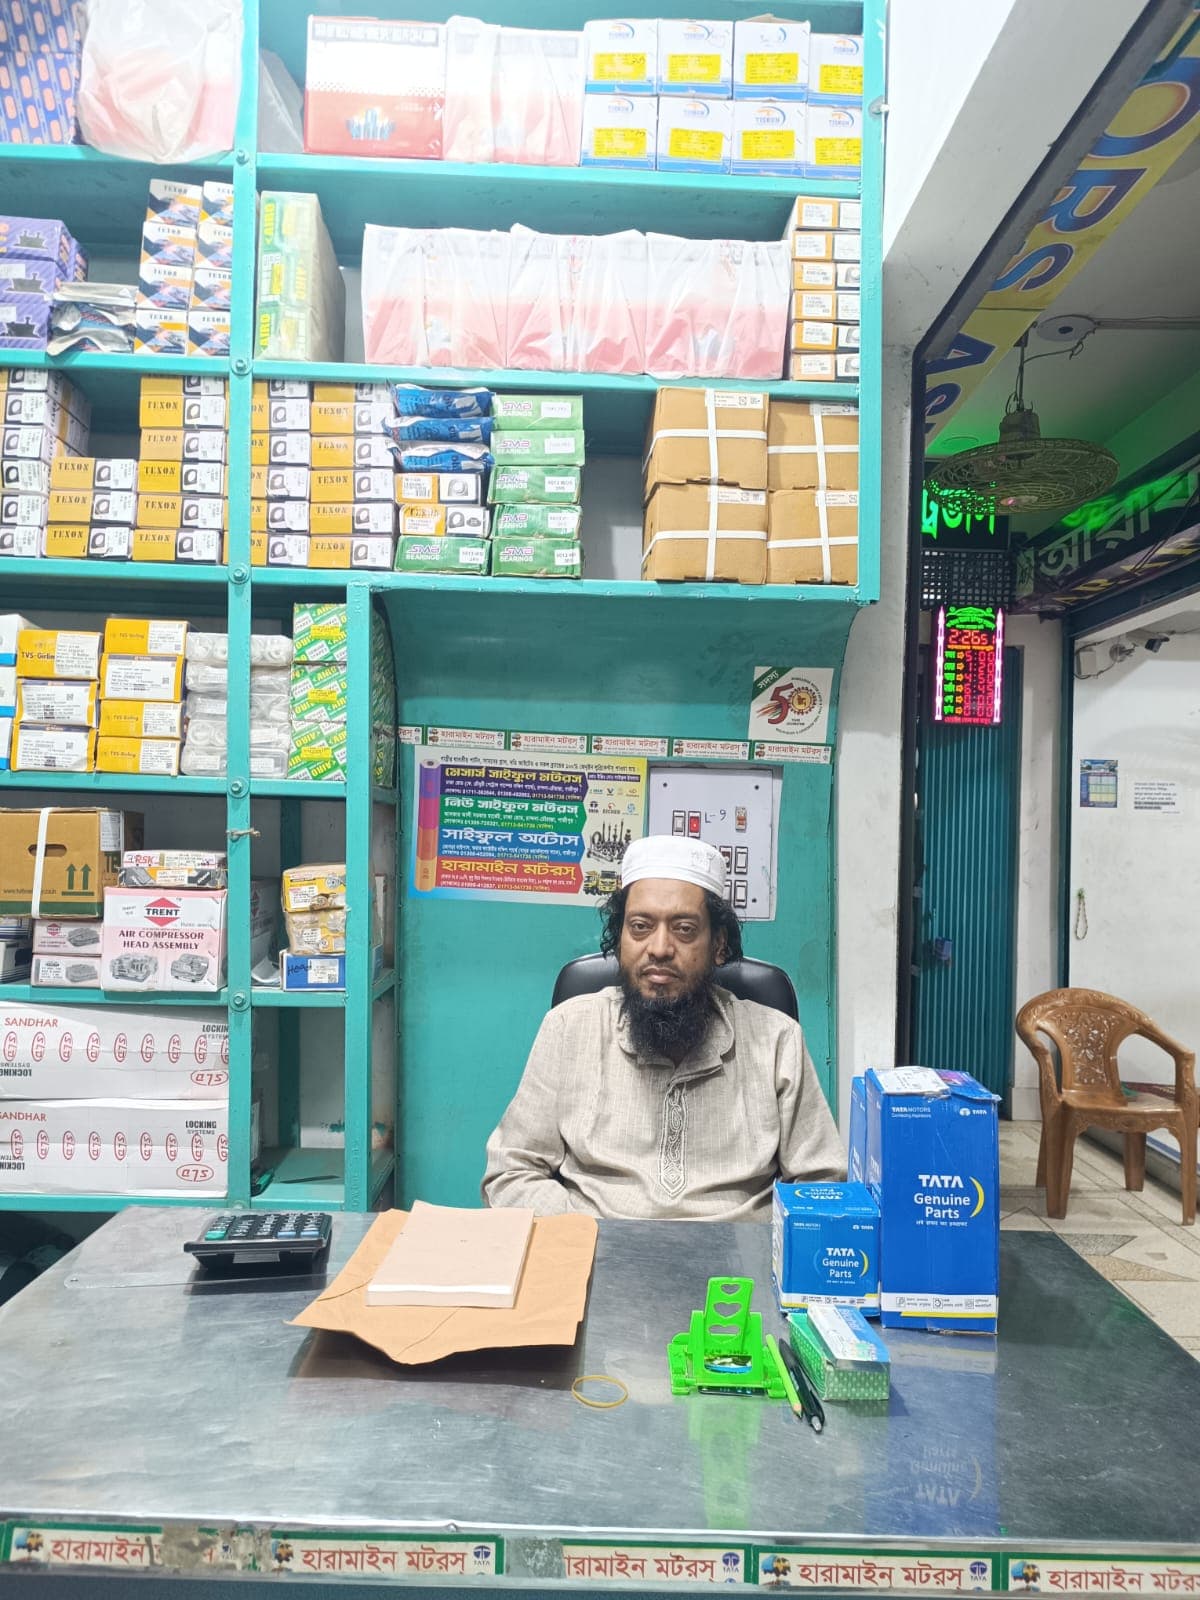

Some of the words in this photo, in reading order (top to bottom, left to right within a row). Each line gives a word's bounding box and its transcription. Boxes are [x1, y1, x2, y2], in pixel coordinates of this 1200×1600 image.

[147, 400, 178, 410] TEXON
[146, 435, 177, 443] TEXON
[58, 462, 89, 472] TEXON
[143, 467, 174, 476] TEXON
[317, 476, 348, 485] TEXON
[56, 496, 87, 504] TEXON
[144, 501, 175, 510] TEXON
[316, 506, 347, 514] TEXON
[53, 531, 83, 539] TEXON
[948, 630, 981, 645] 2:26
[445, 766, 486, 778] মেসার্স
[488, 768, 537, 783] সাইফুল
[539, 771, 583, 788] মটরস্
[444, 797, 475, 808] নিউ
[477, 799, 529, 813] সাইফুল
[532, 802, 580, 818] মটরস্
[442, 827, 514, 845] সাইফুল
[518, 831, 581, 847] অটোস
[441, 859, 519, 874] হারামাইন
[522, 862, 576, 881] মটরস্
[145, 907, 181, 917] TRENT
[119, 930, 136, 939] AIR
[139, 930, 205, 941] COMPRESSOR
[123, 940, 150, 949] HEAD
[152, 941, 200, 951] ASSEMBLY
[4, 1017, 59, 1028] SANDHAR
[202, 1024, 229, 1033] LOCKIN
[185, 1120, 217, 1129] LOCKING
[918, 1174, 964, 1189] TATA
[914, 1192, 971, 1206] Genuine
[925, 1206, 960, 1220] Parts
[826, 1247, 855, 1257] TATA
[822, 1258, 859, 1268] Genuine
[829, 1269, 852, 1278] Parts
[50, 1535, 145, 1564] হারামাইন
[300, 1543, 398, 1571] হারামাইন
[404, 1545, 468, 1574] মটরস্
[564, 1551, 647, 1578] ারামাইন
[653, 1552, 717, 1582] মটরস্
[797, 1559, 895, 1588] হারামাইন
[900, 1560, 965, 1590] মটরস্
[1046, 1564, 1144, 1592] হারামাইন
